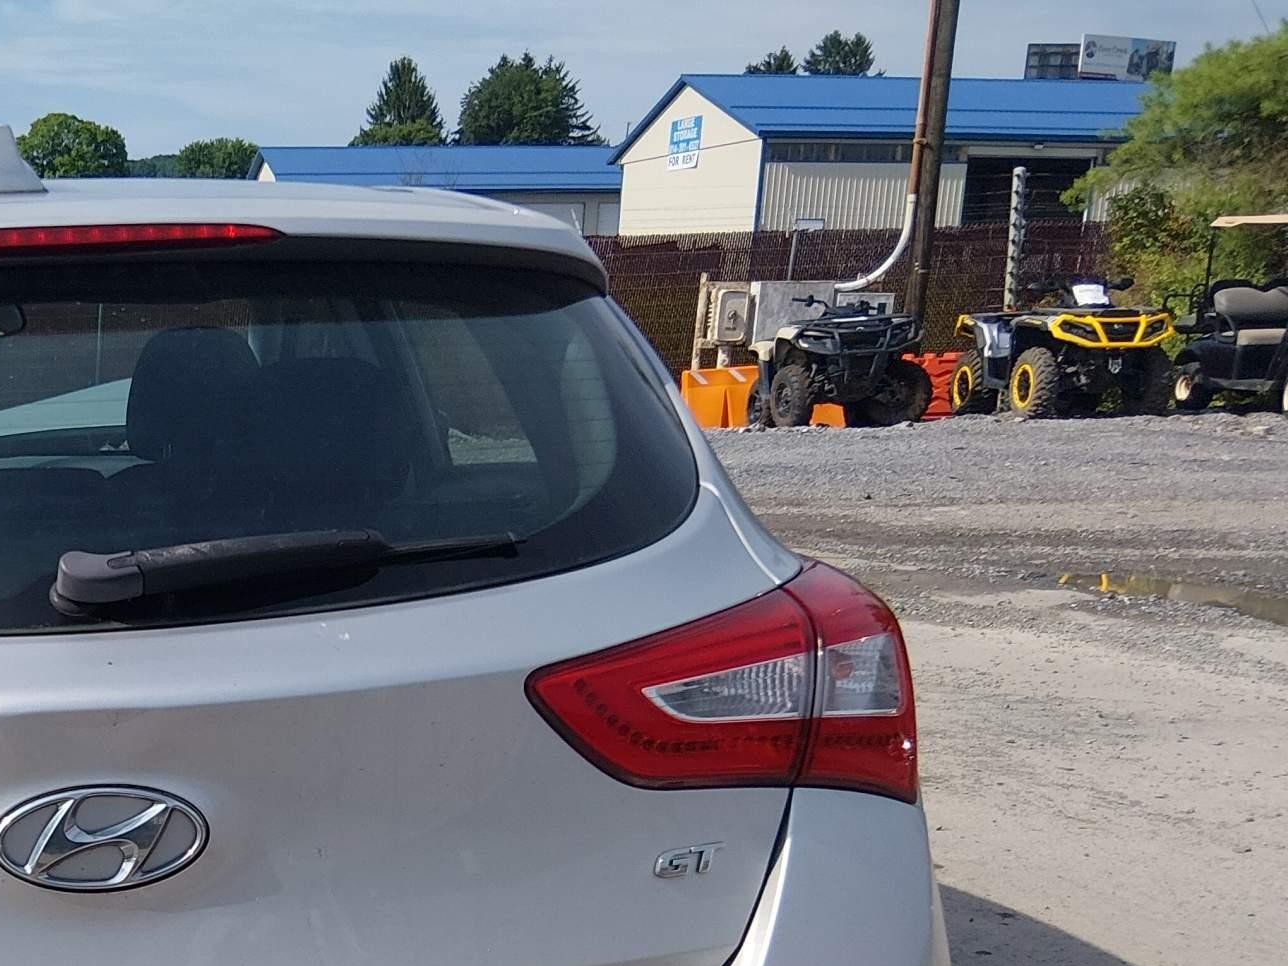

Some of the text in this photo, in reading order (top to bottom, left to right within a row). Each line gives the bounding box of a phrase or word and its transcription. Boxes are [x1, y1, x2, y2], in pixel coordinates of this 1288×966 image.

[668, 152, 697, 167] FOR RENT
[654, 840, 726, 879] GT
